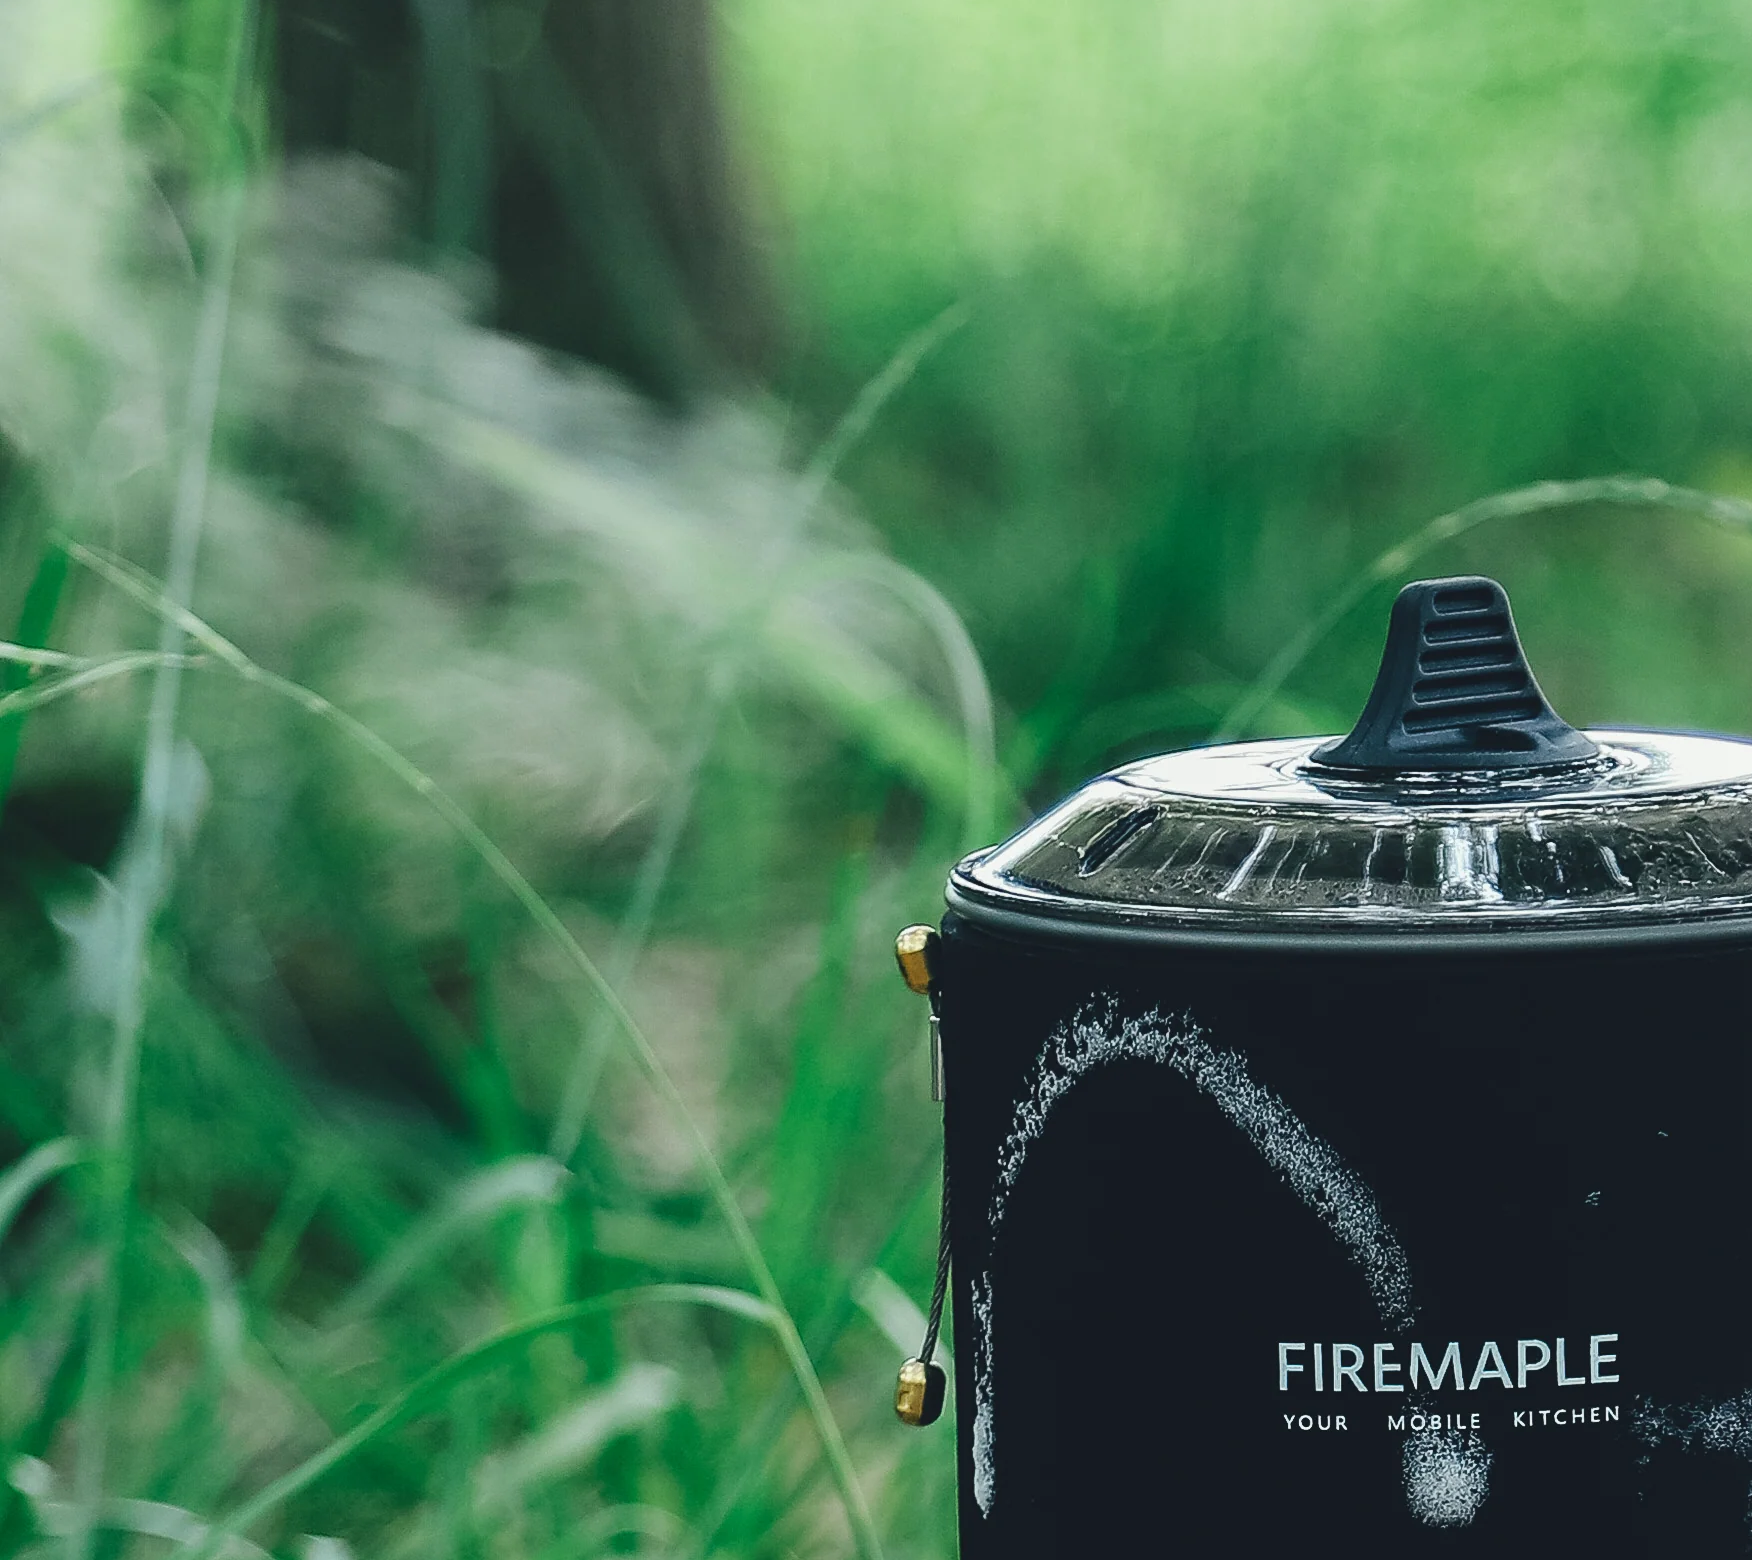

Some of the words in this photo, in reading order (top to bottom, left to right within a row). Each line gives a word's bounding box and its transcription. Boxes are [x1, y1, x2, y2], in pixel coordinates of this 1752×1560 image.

[1278, 1333, 1620, 1392] FIREMAPLE
[1283, 1414, 1348, 1431] YOUR
[1388, 1413, 1481, 1431] MOBILE
[1513, 1406, 1620, 1428] KITCHEN
